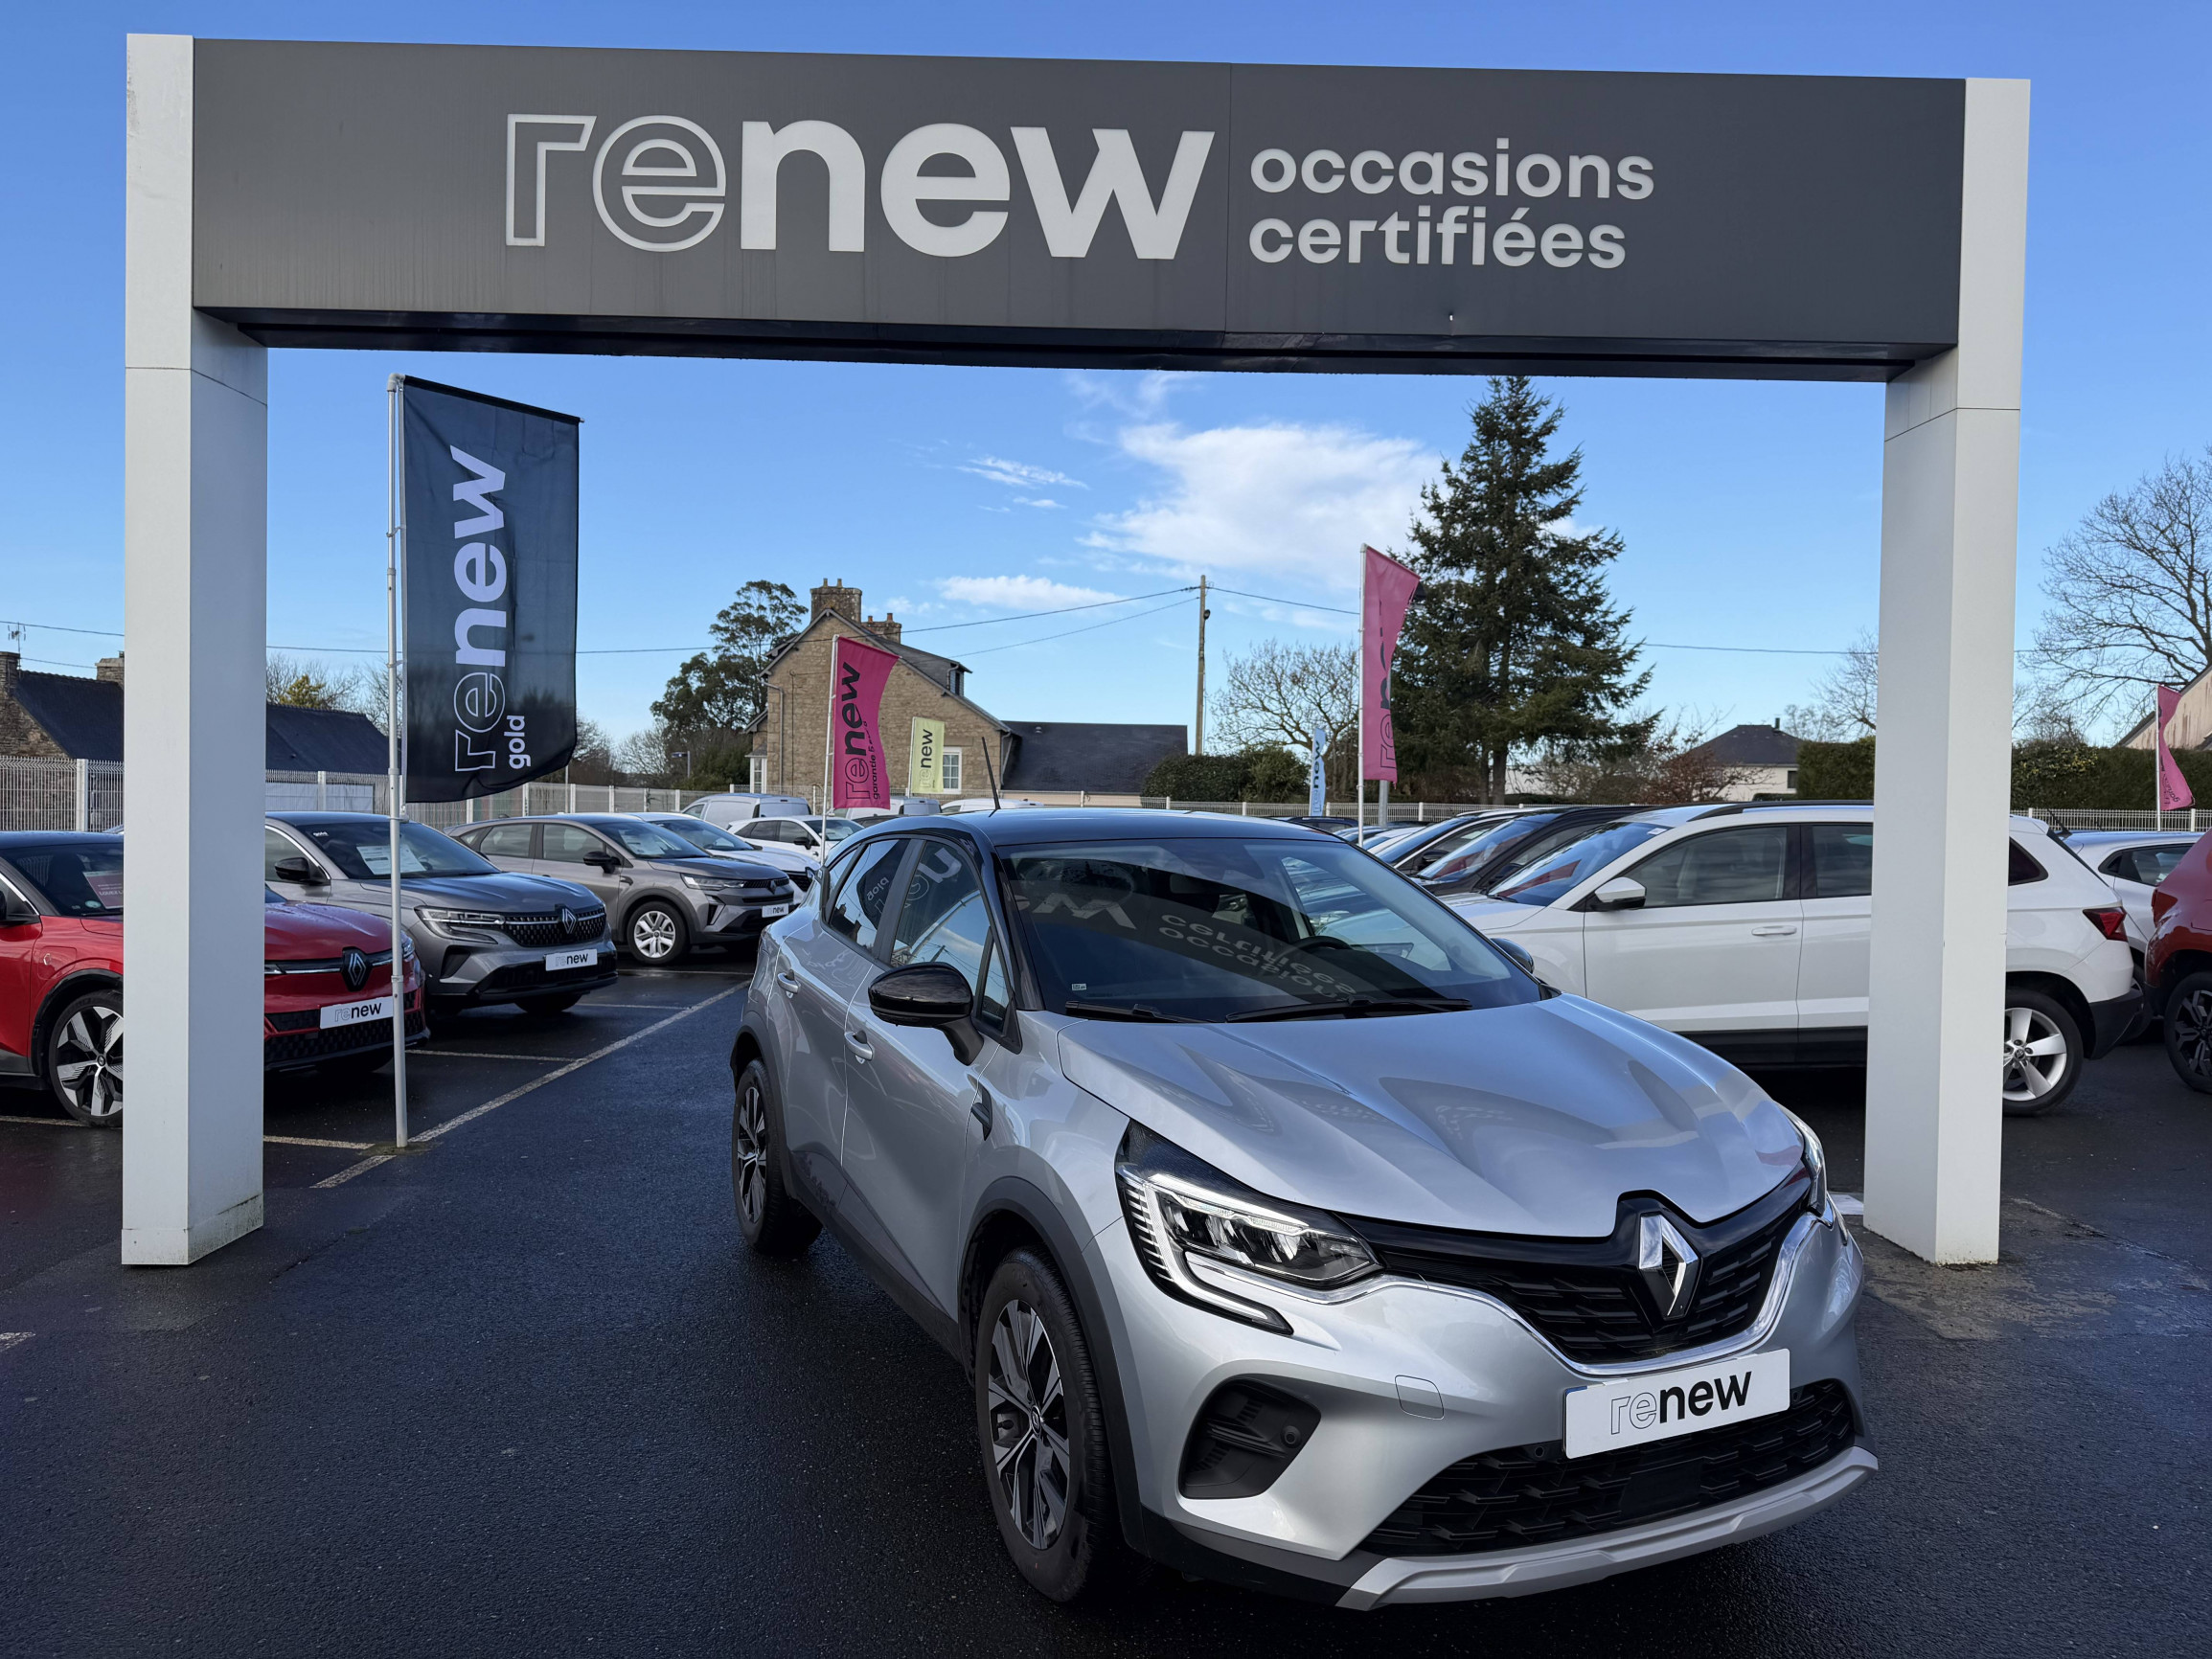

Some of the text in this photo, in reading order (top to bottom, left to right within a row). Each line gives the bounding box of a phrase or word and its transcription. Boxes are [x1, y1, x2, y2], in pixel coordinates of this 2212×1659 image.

[506, 113, 1215, 260] renew
[1250, 137, 1654, 200] occasions
[1248, 204, 1626, 269] certifiées
[449, 444, 507, 772] renew
[504, 715, 531, 769] gold
[841, 662, 871, 800] renew
[919, 728, 933, 788] renew
[555, 953, 588, 966] renew
[334, 1002, 382, 1023] renew
[1610, 1371, 1752, 1435] renew
